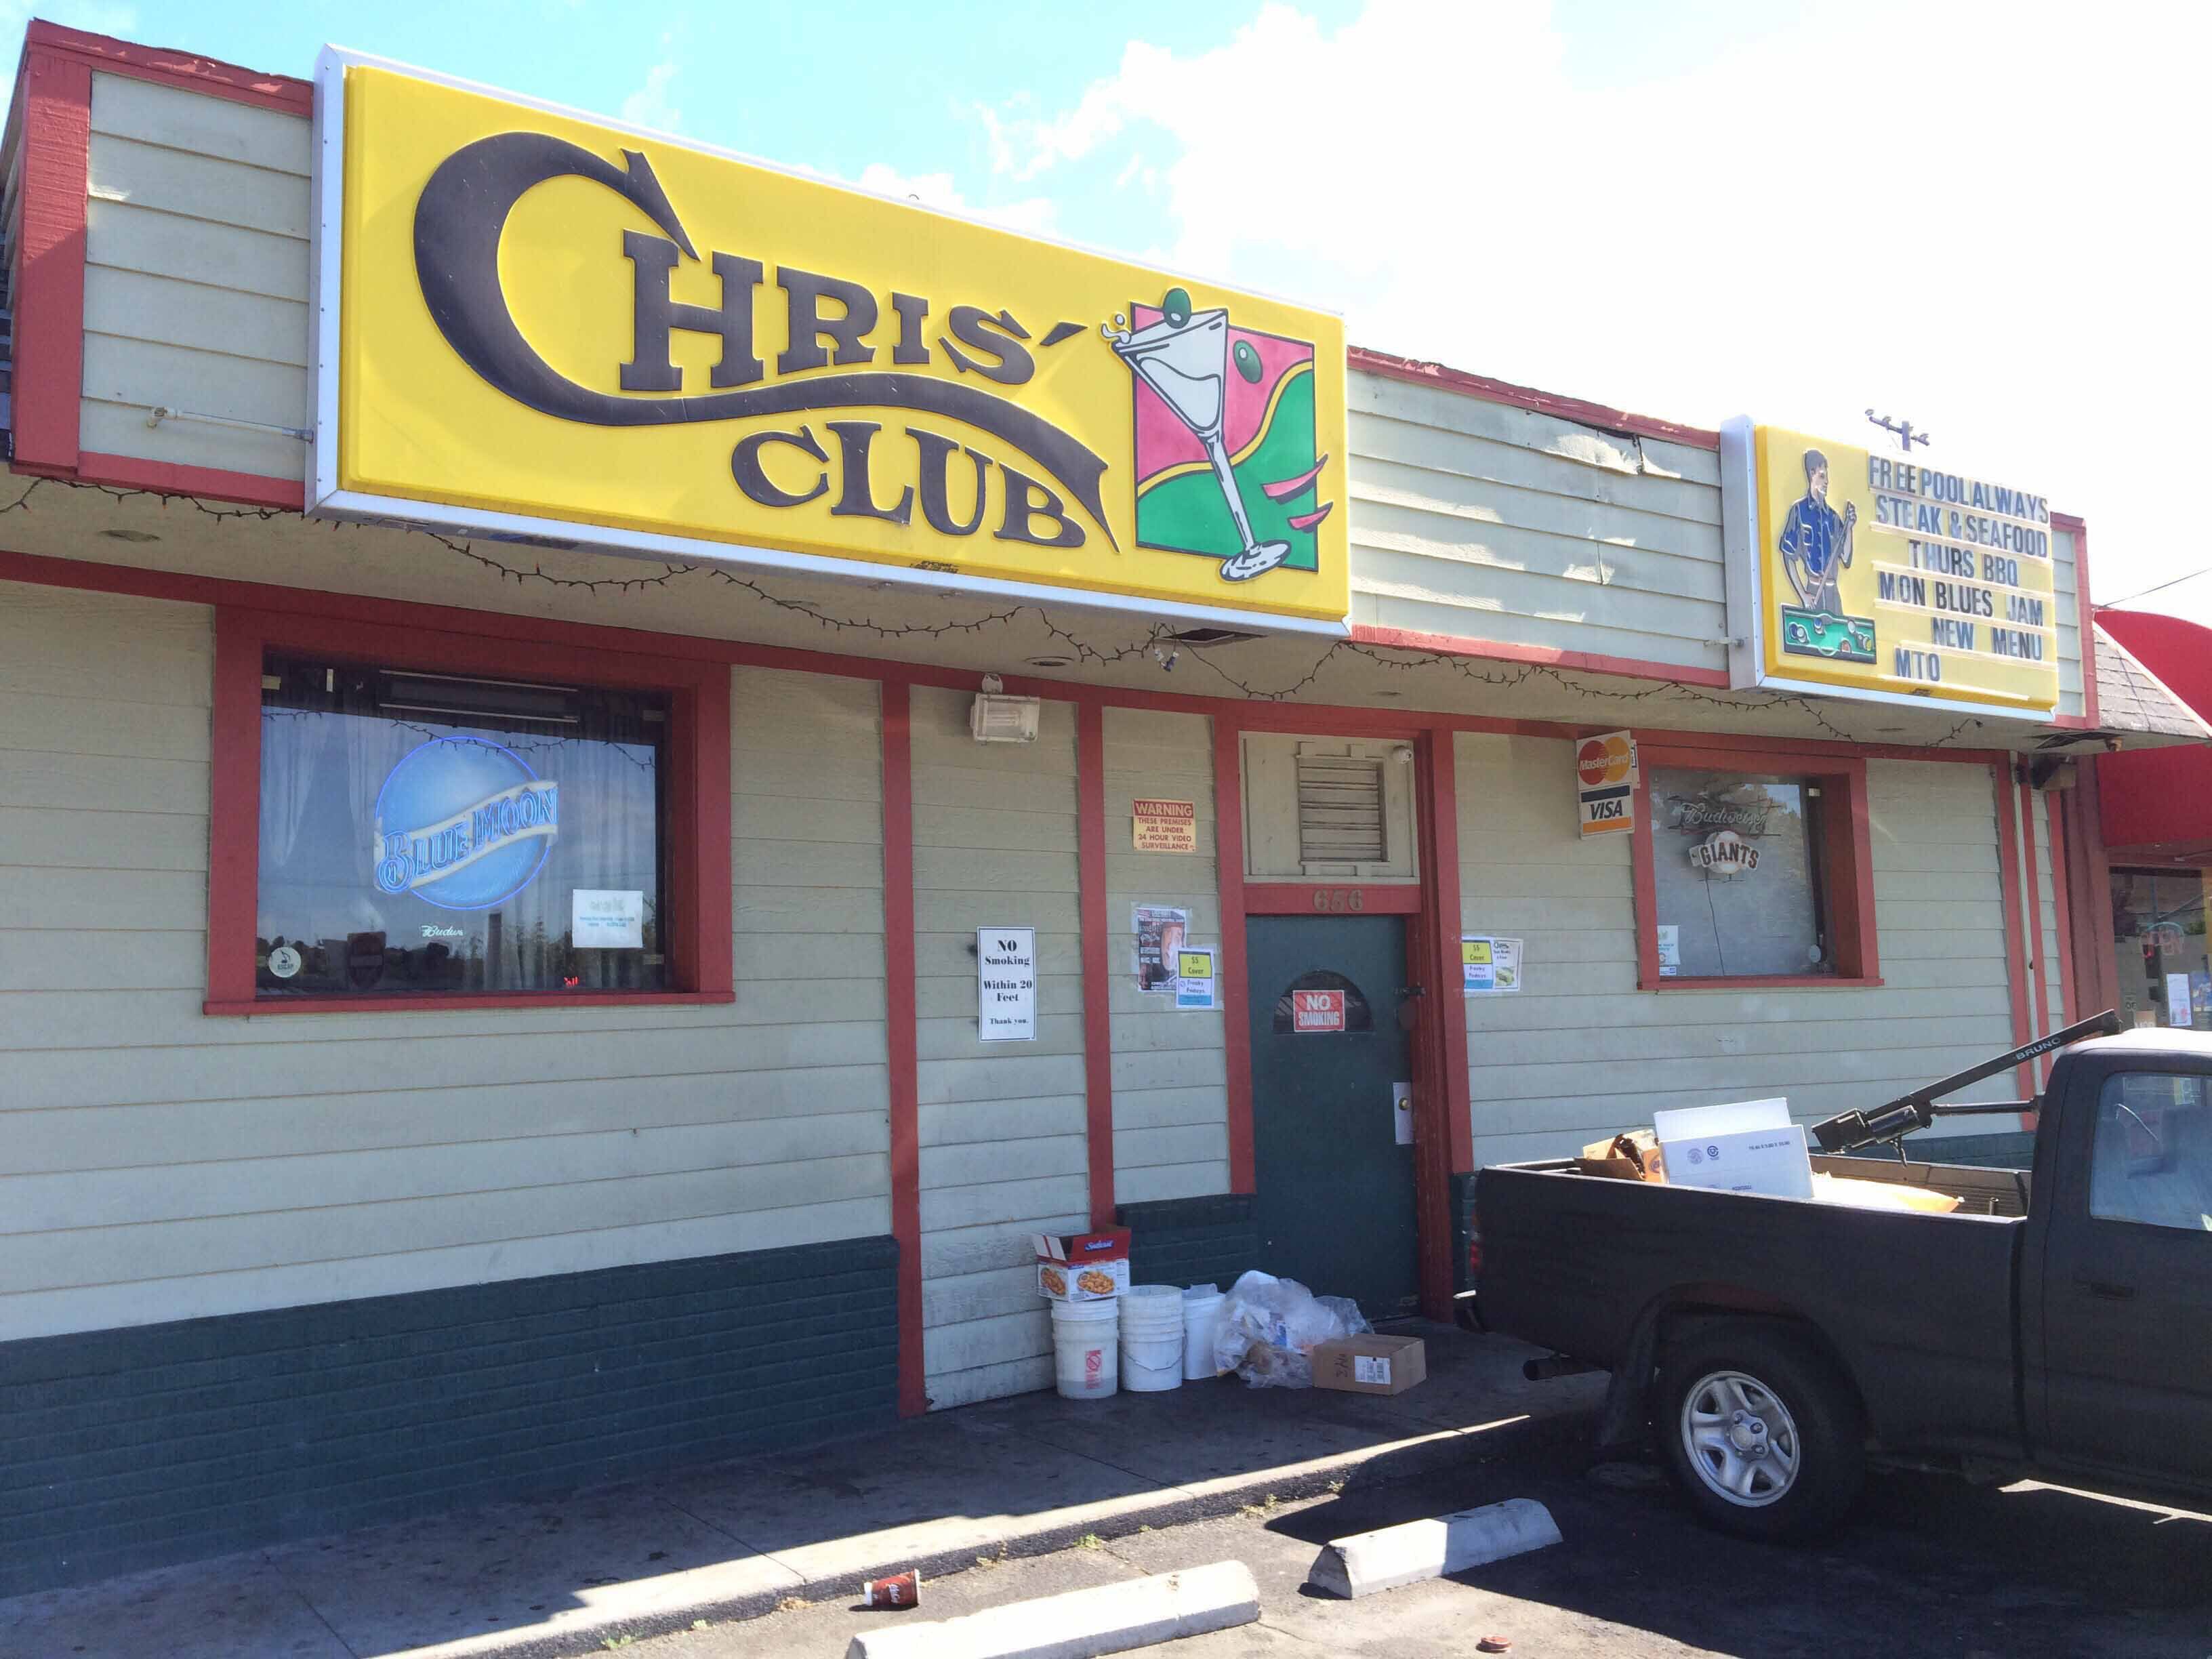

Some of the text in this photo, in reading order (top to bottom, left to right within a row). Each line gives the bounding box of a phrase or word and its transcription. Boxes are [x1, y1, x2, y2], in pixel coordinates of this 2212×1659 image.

[731, 419, 1086, 548] CLUB
[1868, 455, 2049, 525] FREE POOL ALWAYS
[1876, 495, 2047, 558] STEAK & SEAFOOD
[1909, 539, 2018, 587] THURS BBQ
[1879, 571, 2044, 627] MON BLUES JAM
[1932, 617, 2043, 661] NEW MENU
[1895, 647, 1942, 682] MTO
[1580, 752, 1629, 771] MasterCard
[1134, 802, 1193, 817] WARNING
[1590, 800, 1623, 821] VISA
[1160, 818, 1191, 826] PREMISES
[378, 787, 558, 893] BLUE MOON
[1141, 842, 1189, 851] SURVEILLANCE
[1700, 842, 1759, 869] GIANTS
[1313, 888, 1364, 912] 656
[997, 939, 1017, 952] NO
[984, 956, 1031, 968] Smoking
[983, 980, 1033, 990] Within 20
[997, 992, 1020, 1002] Feet
[1306, 994, 1331, 1010] NO
[1298, 1011, 1340, 1026] SMOKING
[2016, 1037, 2060, 1060] BRUNO
